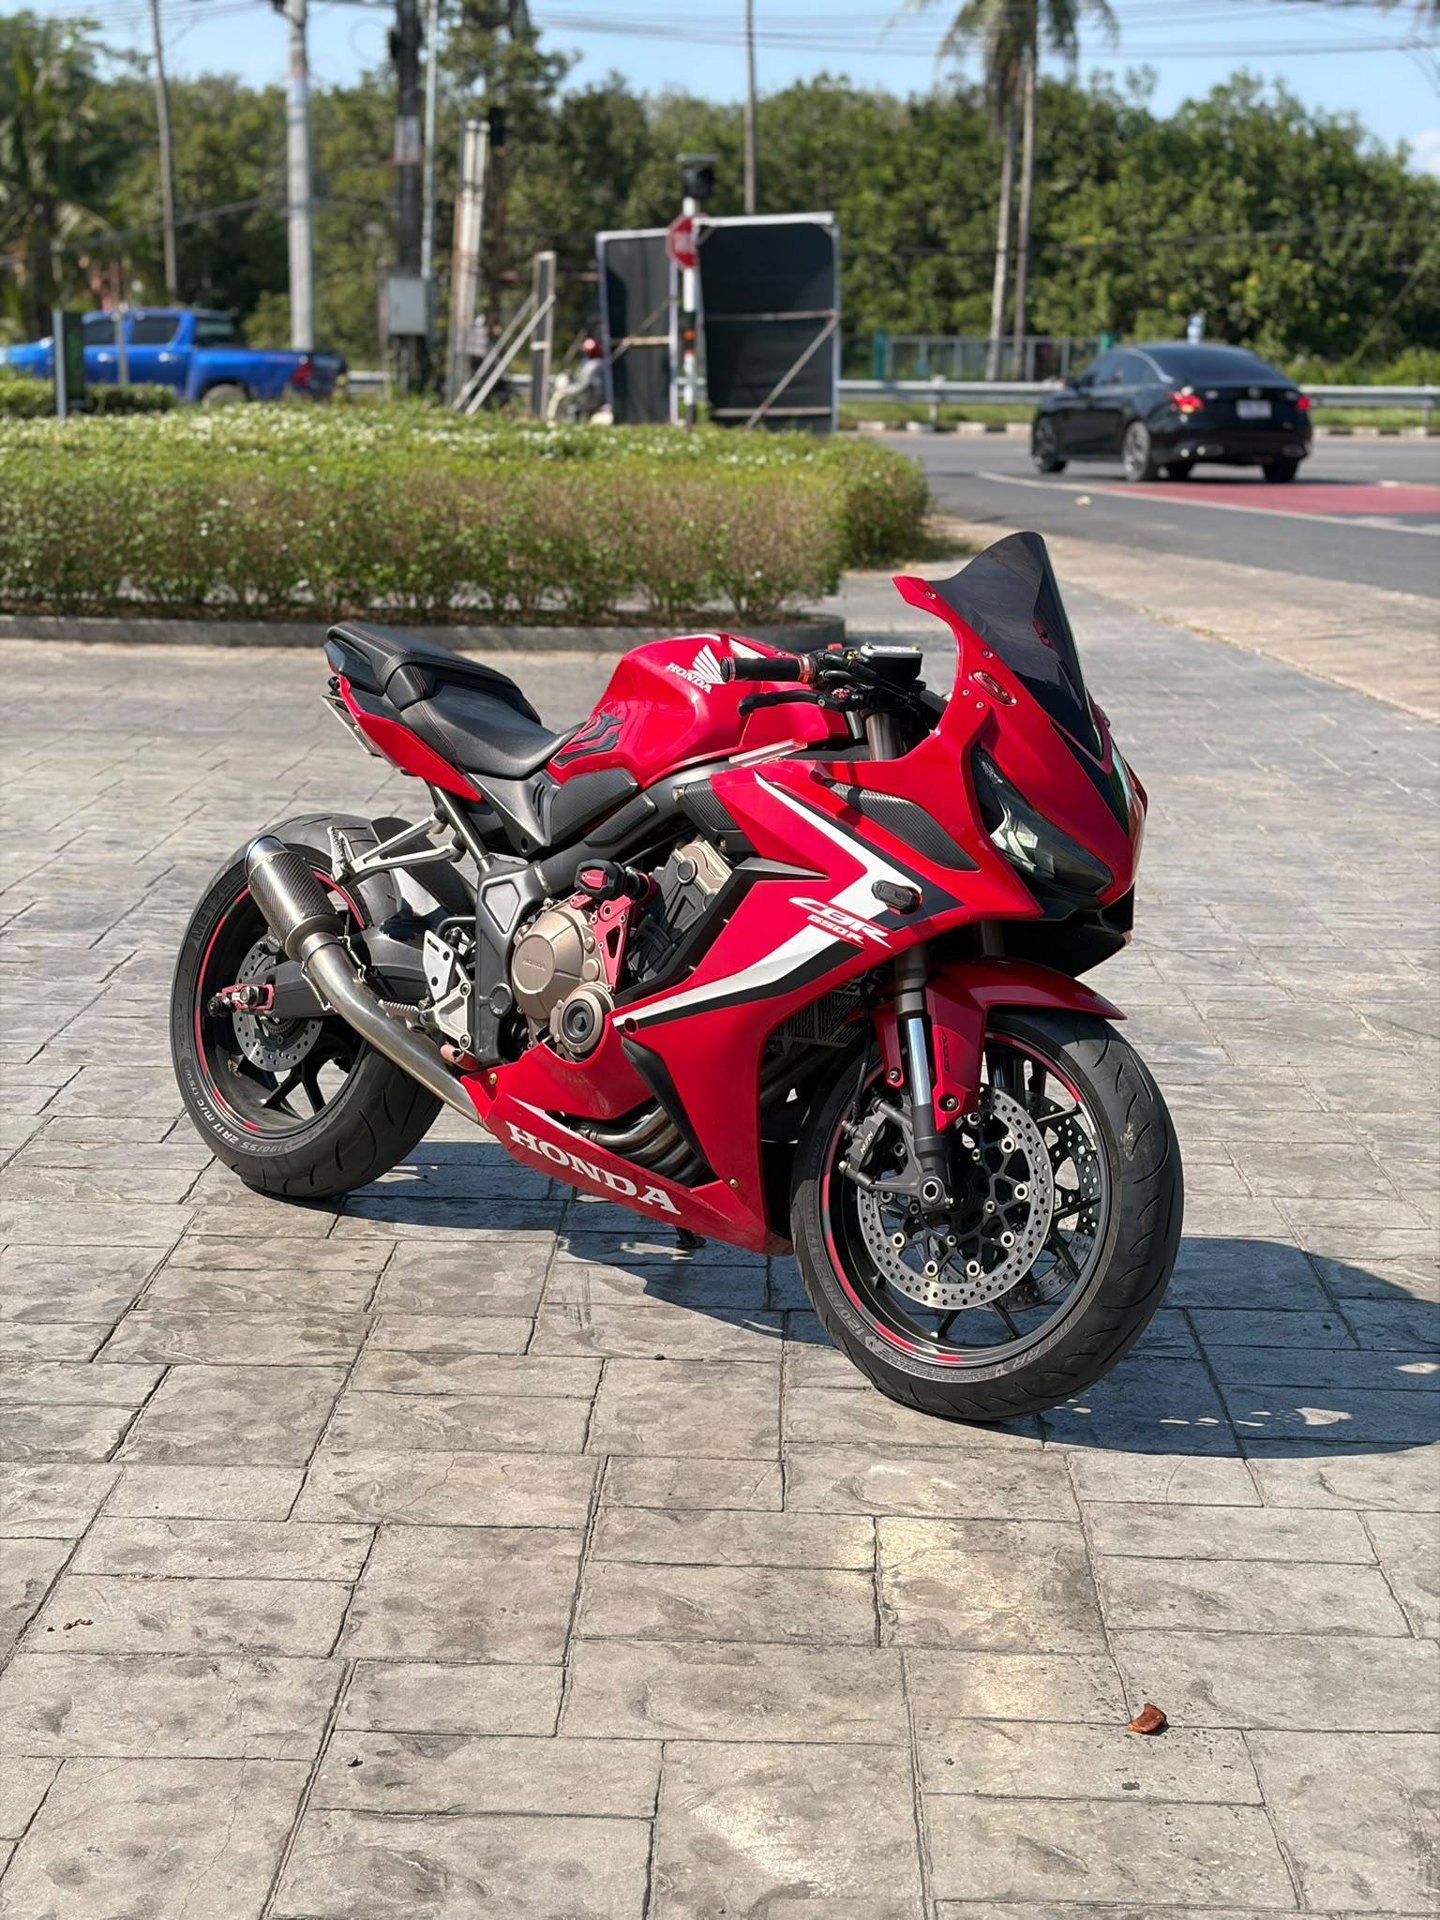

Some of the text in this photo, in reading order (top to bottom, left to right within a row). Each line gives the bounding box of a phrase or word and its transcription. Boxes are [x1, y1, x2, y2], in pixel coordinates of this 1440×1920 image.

[665, 661, 713, 695] HONDA
[788, 897, 893, 949] CBR
[807, 913, 865, 945] 650R
[505, 1120, 682, 1216] HONDA
